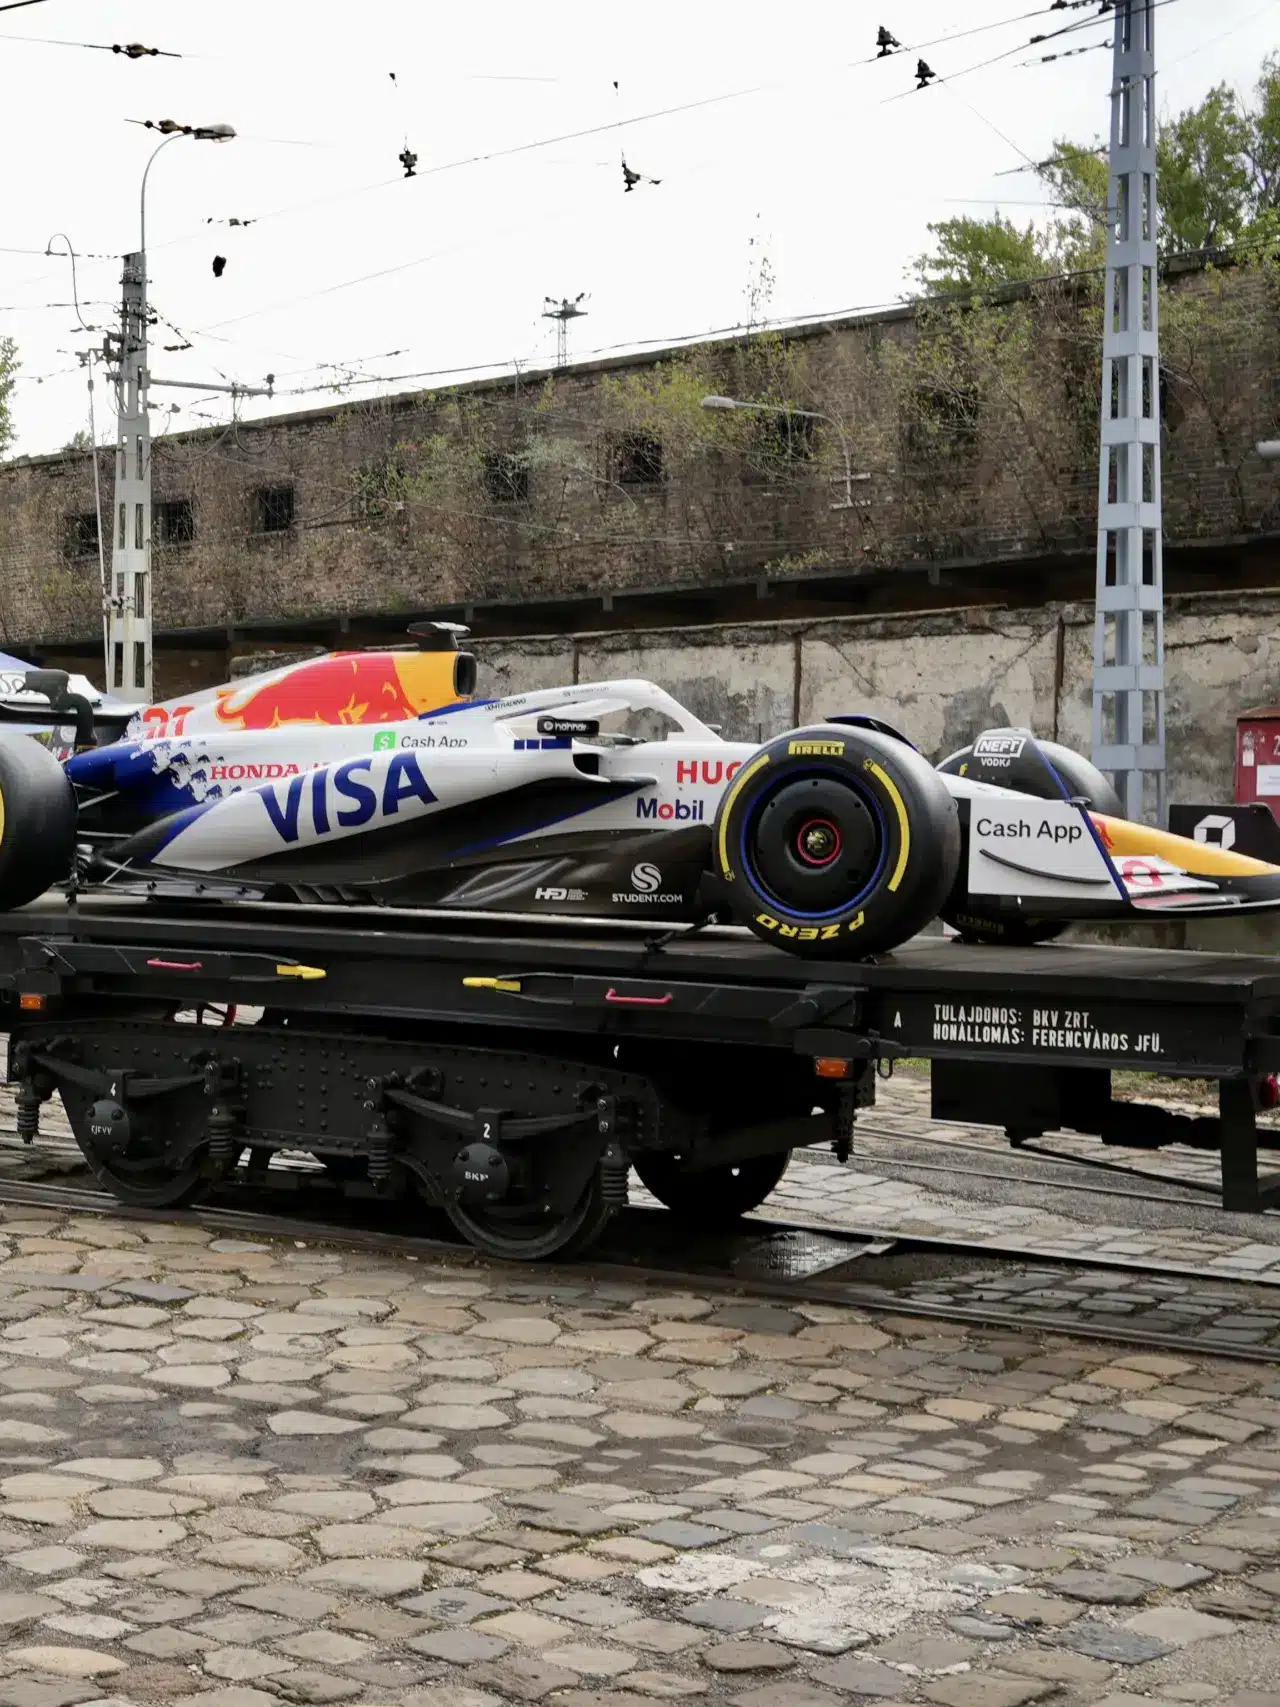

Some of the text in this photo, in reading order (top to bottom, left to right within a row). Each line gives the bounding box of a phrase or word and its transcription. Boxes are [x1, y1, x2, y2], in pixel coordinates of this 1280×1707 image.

[401, 735, 469, 749] Cash App
[788, 740, 845, 756] PIRELLI
[978, 739, 1022, 754] NEFT
[980, 757, 1011, 767] VODKA
[210, 763, 300, 781] HONDA
[676, 760, 743, 785] HU
[259, 749, 439, 844] VISA
[636, 797, 704, 820] Mobil
[977, 817, 1082, 844] Cash App
[612, 893, 684, 903] STUDENT.COM
[756, 911, 865, 941] P ZERO
[893, 1010, 902, 1028] A
[933, 1004, 1095, 1029] TULAJDONOS: BKV ZRT.
[483, 1122, 491, 1139] 2
